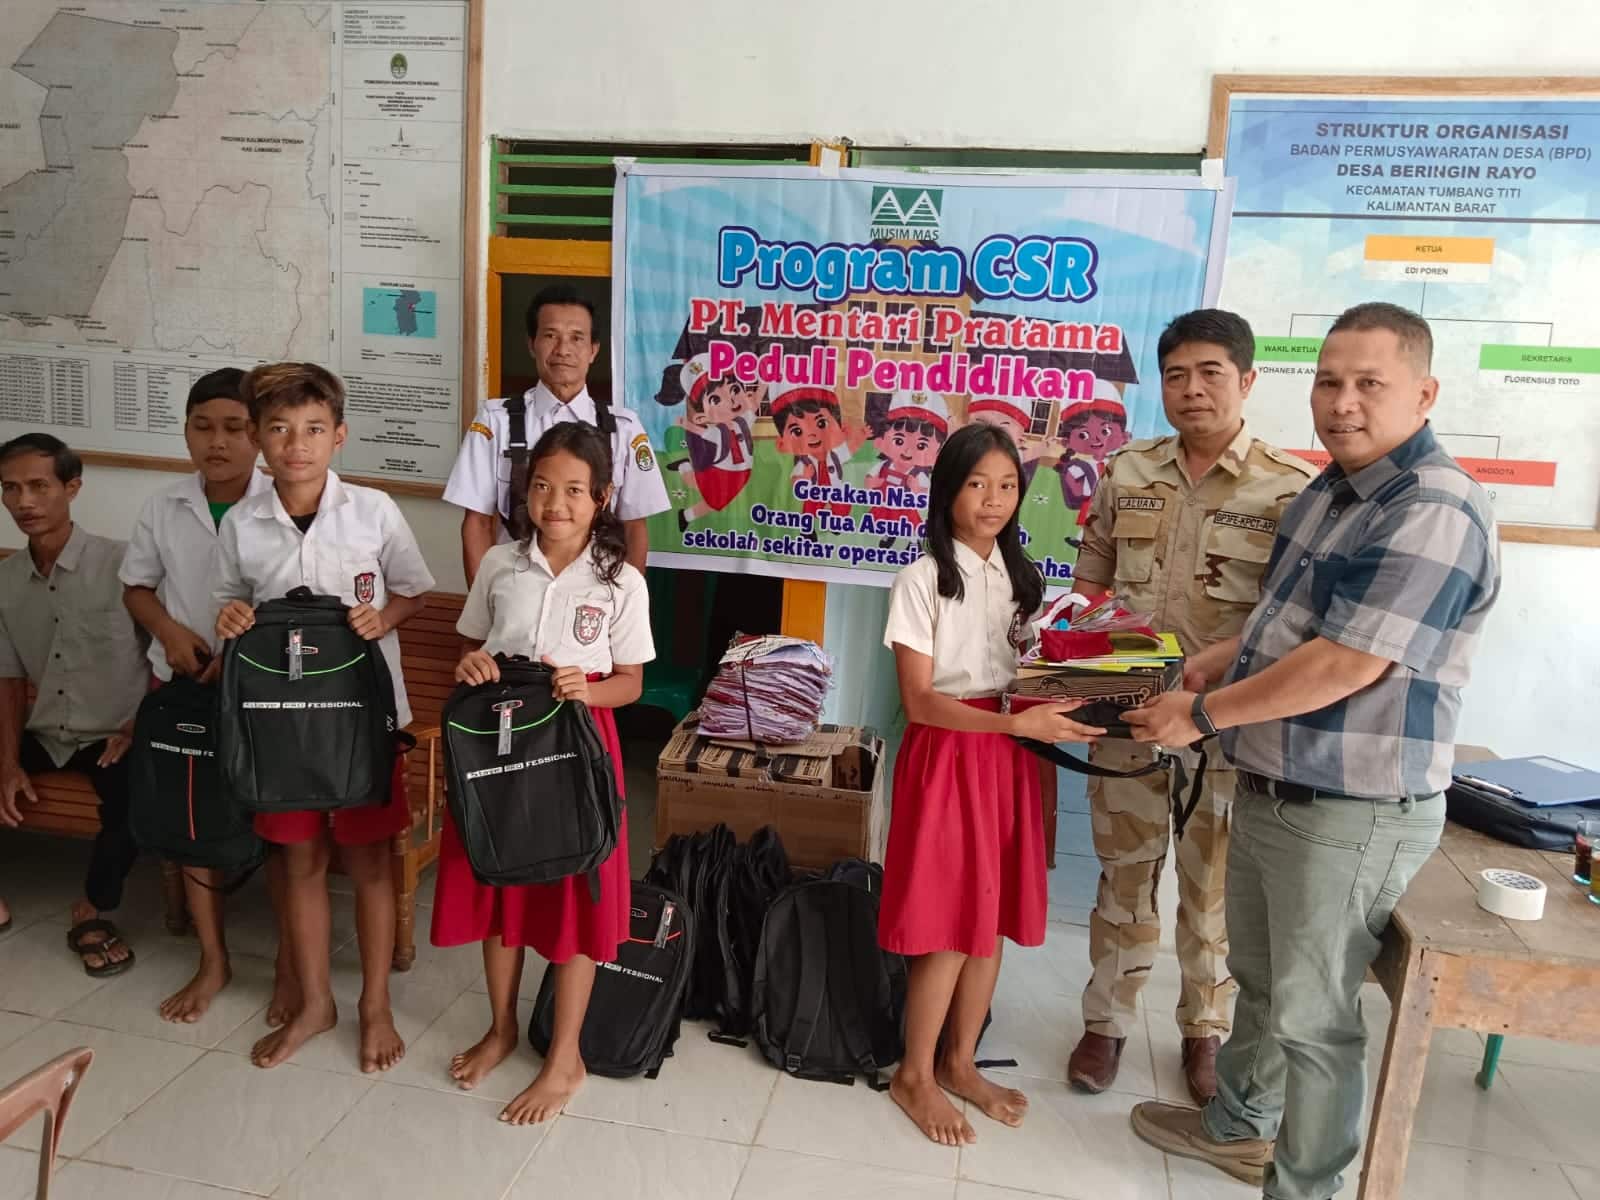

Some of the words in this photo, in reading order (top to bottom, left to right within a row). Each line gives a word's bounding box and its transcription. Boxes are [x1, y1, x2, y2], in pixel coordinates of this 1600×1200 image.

[1316, 123, 1429, 139] STRUKTUR
[1436, 124, 1569, 140] ORGANISASI
[1290, 144, 1341, 156] BADAN
[1345, 145, 1499, 159] PERMUSYAWARATAN
[1503, 147, 1544, 159] DESA
[1549, 147, 1592, 162] (BPD)
[1337, 164, 1384, 177] DESA
[1390, 165, 1481, 179] BERINGIN
[1486, 166, 1537, 179] RAYO
[1346, 185, 1425, 197] KECAMATAN
[1429, 186, 1494, 198] TUMBANG
[1498, 188, 1521, 198] TITI
[1367, 201, 1450, 213] KALIMANTAN
[1454, 203, 1496, 214] BARAT
[870, 228, 910, 240] MUSIM
[912, 229, 939, 241] MAS
[1415, 245, 1442, 253] KETUA
[719, 226, 965, 301] Program
[972, 234, 1098, 302] CSR
[1405, 266, 1418, 274] EDI
[688, 298, 750, 336] PT.
[761, 302, 920, 344] Mentari
[929, 309, 1123, 354] Pratama
[1264, 345, 1289, 353] WAKIL
[708, 340, 836, 387] Peduli
[846, 352, 1096, 401] Pendidikan
[1259, 366, 1295, 374] YOHANES
[1504, 375, 1556, 385] FLORENSIUS
[1558, 377, 1581, 385] TOTO
[793, 480, 882, 507] Gerakan
[887, 486, 928, 509] Nas
[751, 507, 814, 532] Orang
[816, 510, 855, 533] Tua
[860, 514, 911, 538] Asuh
[684, 529, 758, 552] sekolah
[762, 535, 833, 558] sekitar
